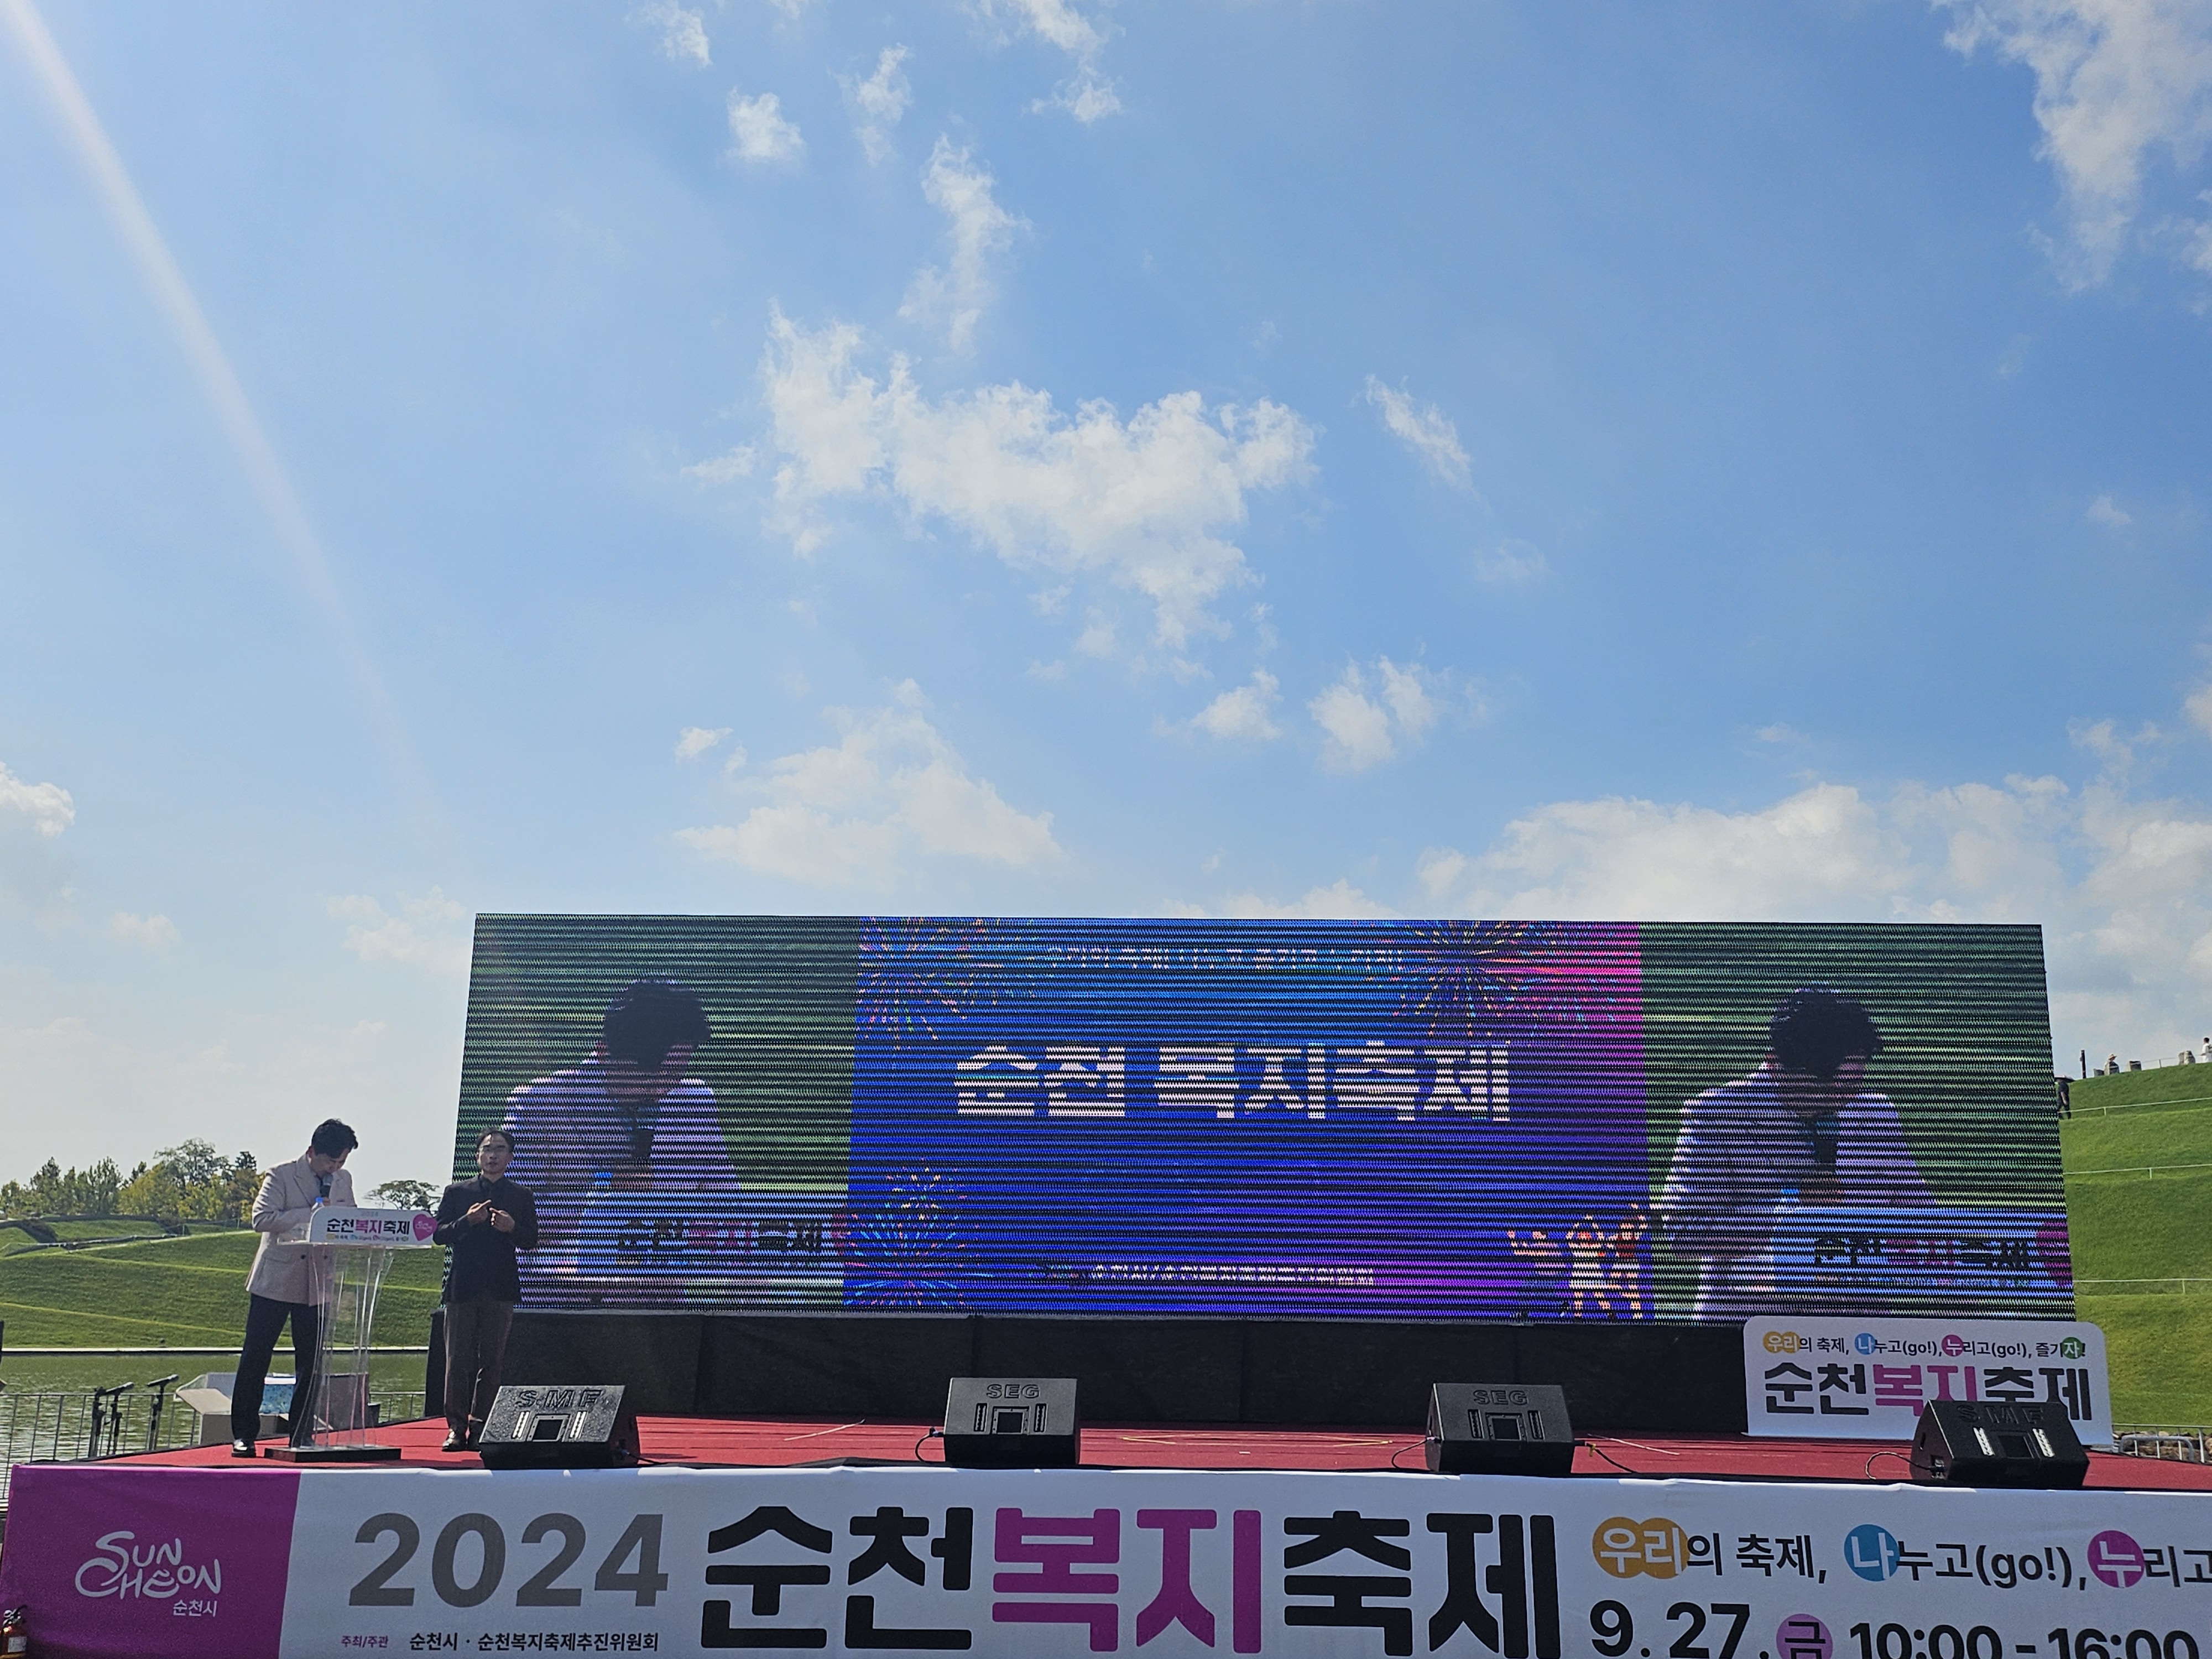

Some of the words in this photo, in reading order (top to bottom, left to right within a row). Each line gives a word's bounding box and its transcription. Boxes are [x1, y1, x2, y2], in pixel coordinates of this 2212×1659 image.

[327, 1218, 410, 1235] 순천복지축제
[1768, 1335, 1812, 1353] 우리의
[1817, 1337, 1849, 1355] 축제,
[2036, 1341, 2086, 1358] 즐기자!
[515, 1390, 603, 1407] SMF
[987, 1384, 1040, 1399] SEG
[1473, 1390, 1528, 1405] SEG
[96, 1531, 181, 1586] SUN
[349, 1512, 669, 1608] 2024
[1600, 1527, 1723, 1576] 우리의
[1736, 1534, 1827, 1584] 축제,
[700, 1506, 1562, 1659] 순천복지축제
[173, 1599, 217, 1617] 순천시
[341, 1635, 389, 1648] 주최/주관
[409, 1632, 458, 1651] 순천시
[478, 1632, 659, 1652] 순천복지축제추진위원회
